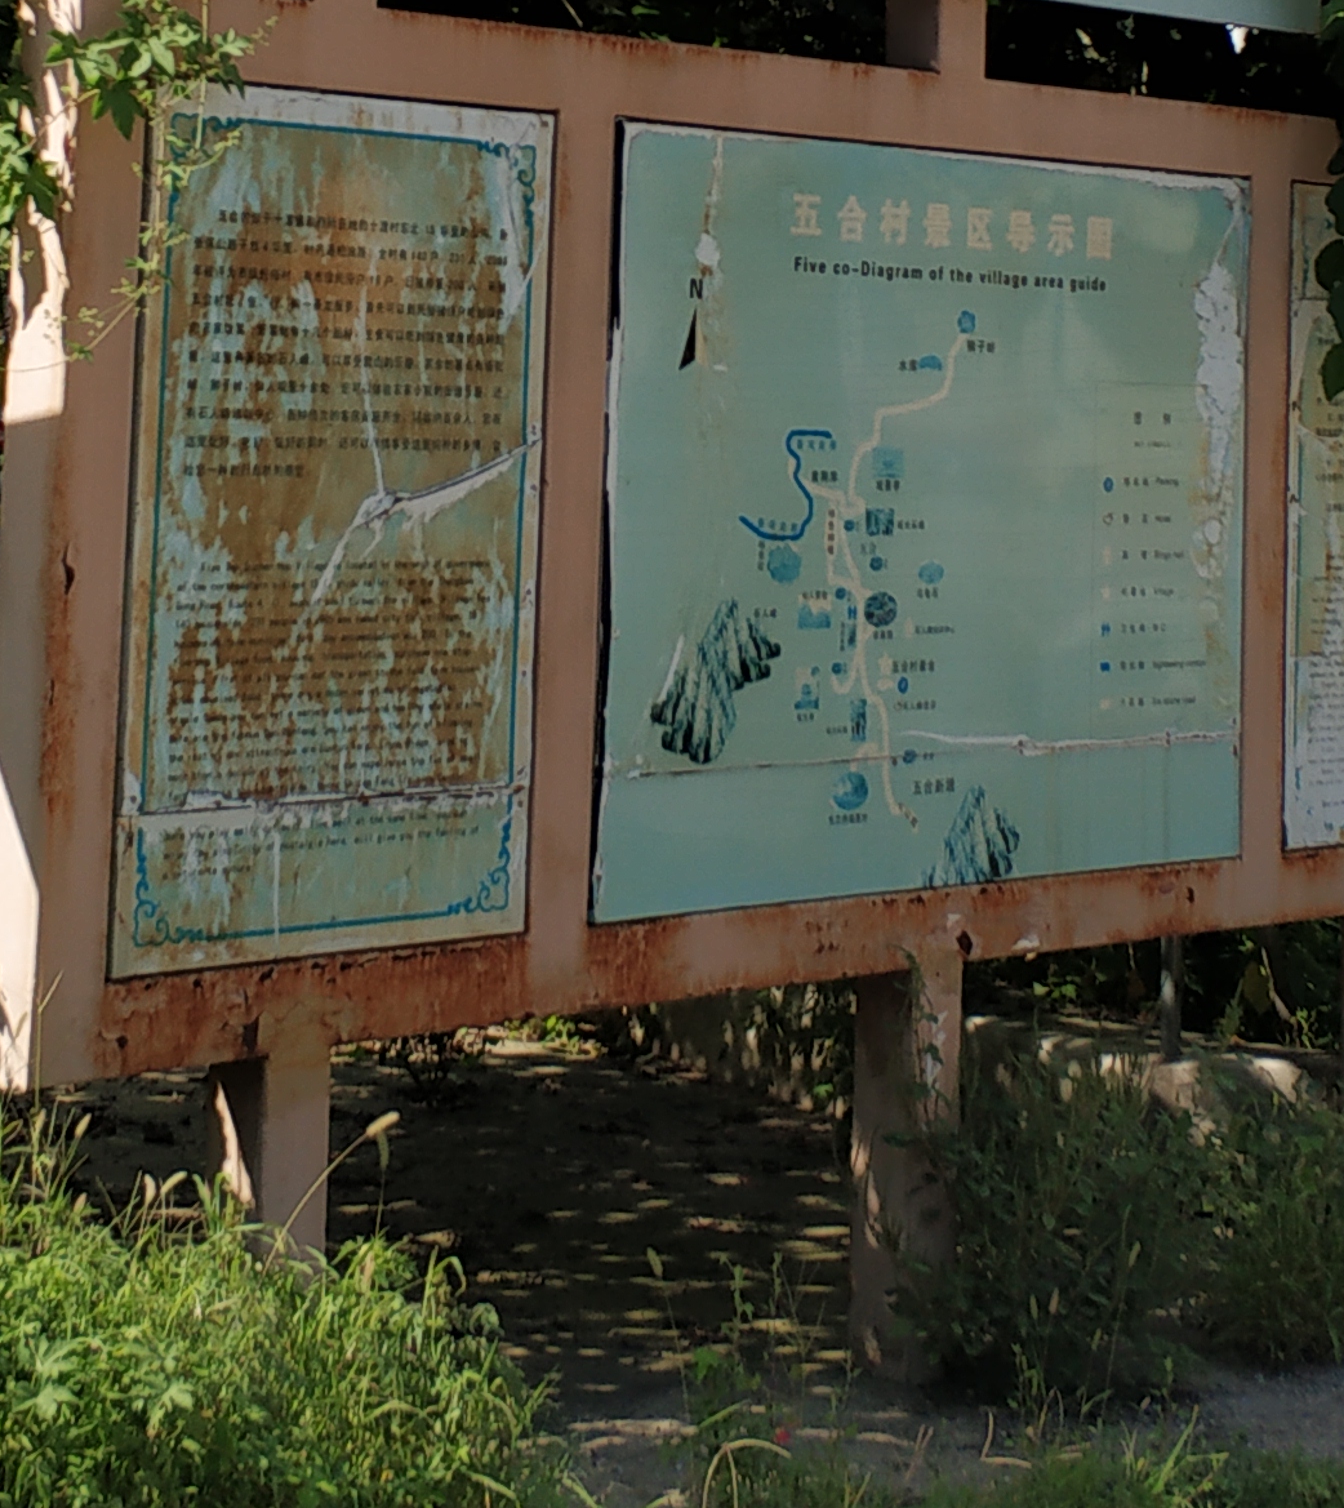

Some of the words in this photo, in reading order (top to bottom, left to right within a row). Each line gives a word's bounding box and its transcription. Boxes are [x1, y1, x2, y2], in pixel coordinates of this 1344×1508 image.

[689, 277, 704, 300] N
[794, 256, 827, 275] Five
[833, 260, 923, 282] co-Diagram
[928, 266, 944, 281] of
[950, 268, 973, 284] the
[978, 270, 1028, 289] village
[1034, 276, 1064, 289] area
[1069, 276, 1107, 293] guide
